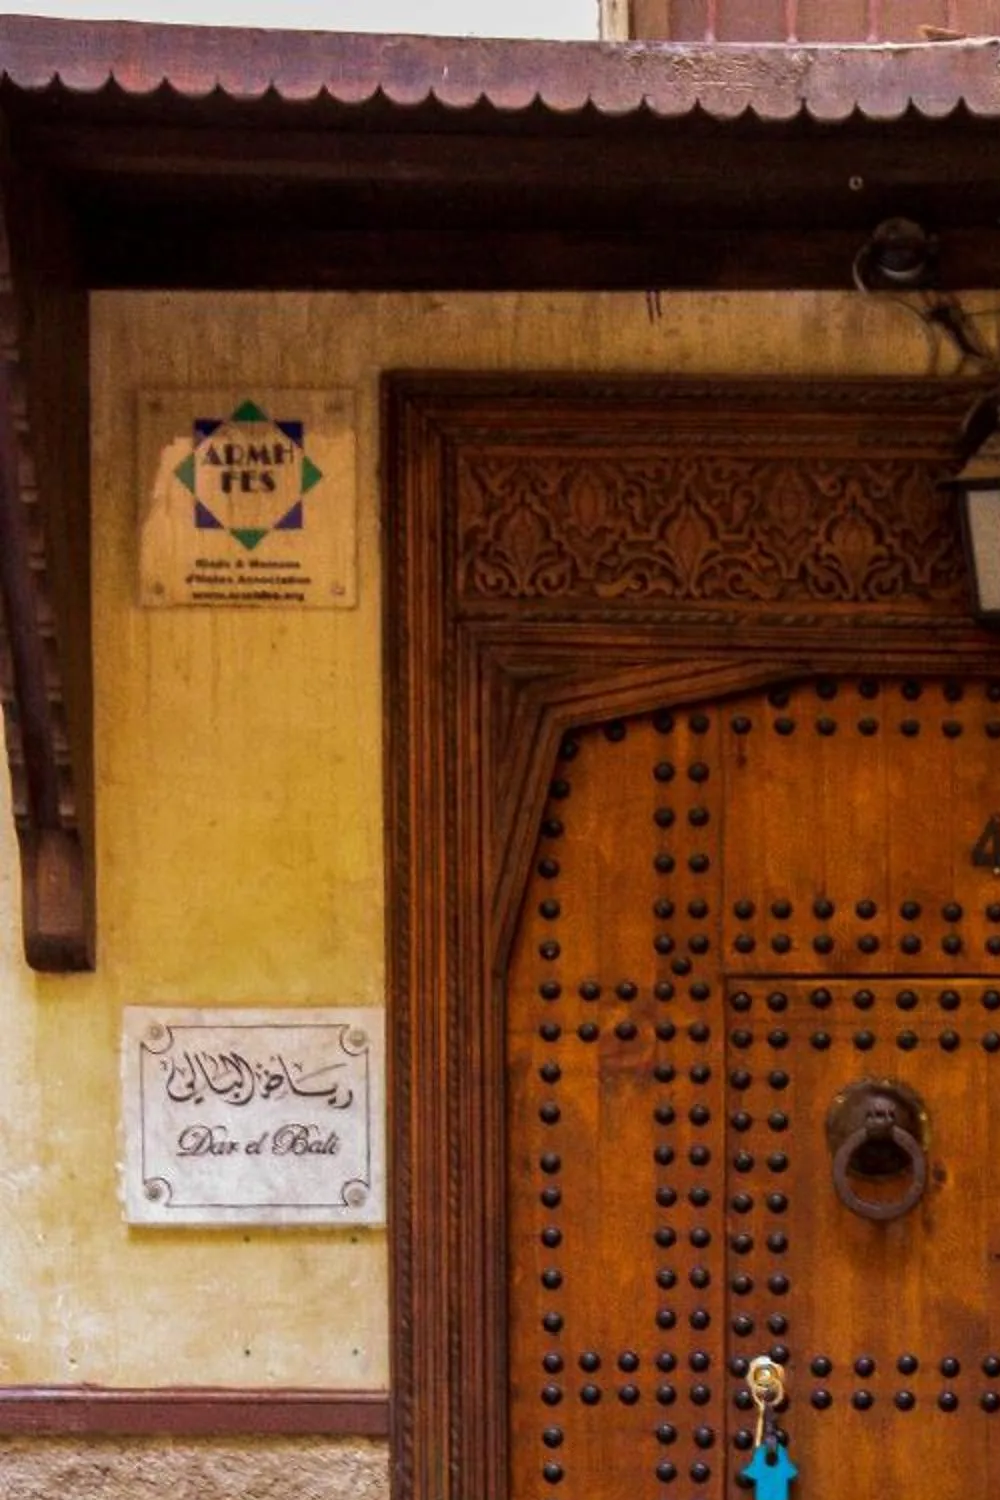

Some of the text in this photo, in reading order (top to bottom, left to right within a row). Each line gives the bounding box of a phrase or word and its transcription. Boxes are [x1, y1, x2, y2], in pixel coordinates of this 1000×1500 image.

[221, 470, 276, 493] FES
[176, 1123, 340, 1156] Dar el Bali
